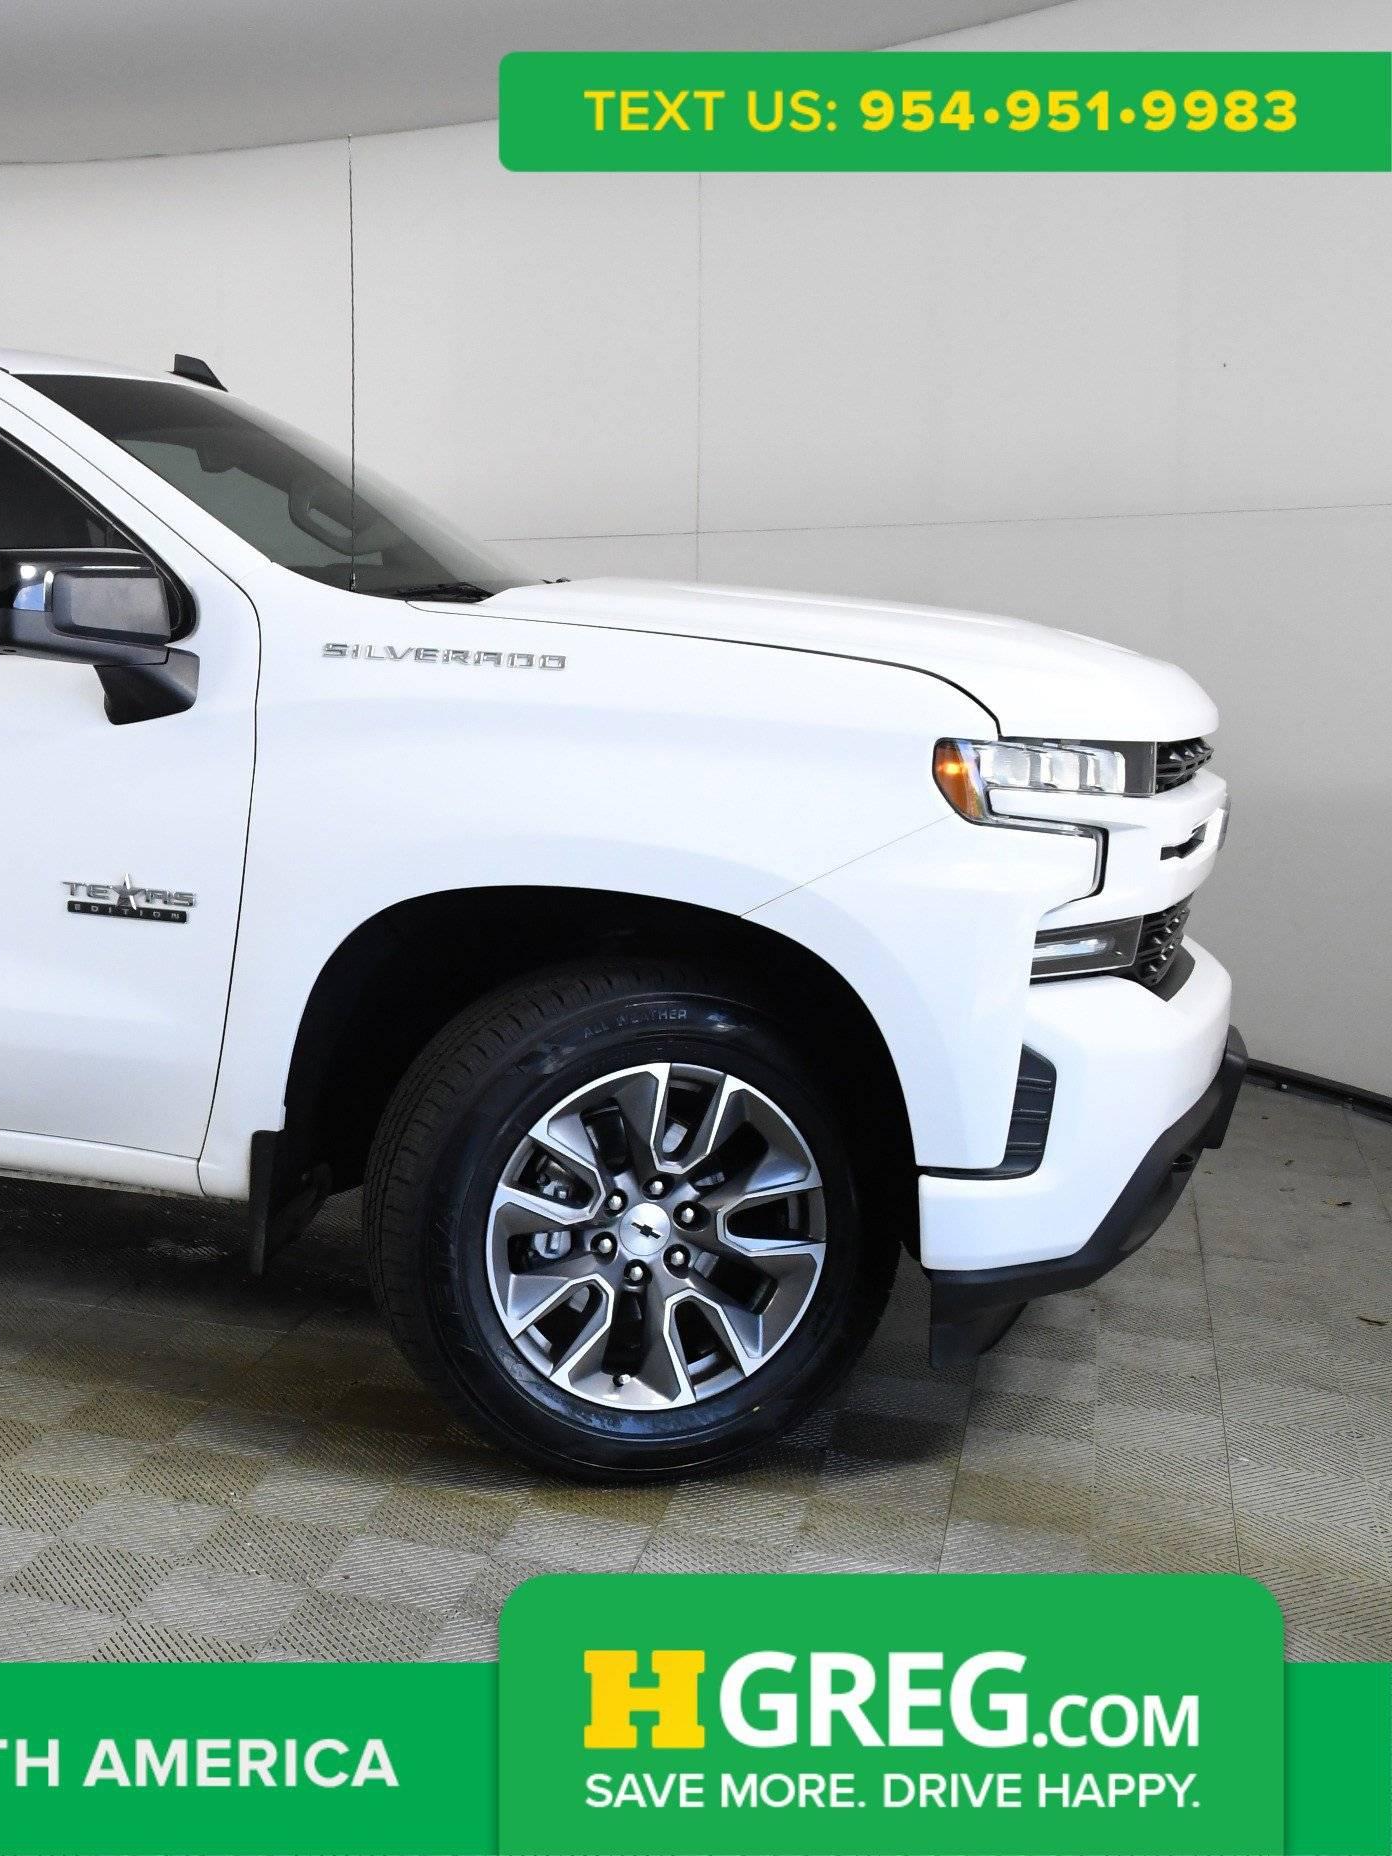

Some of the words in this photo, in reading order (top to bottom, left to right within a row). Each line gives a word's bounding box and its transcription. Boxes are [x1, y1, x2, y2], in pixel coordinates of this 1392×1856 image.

[321, 642, 567, 671] SILVERADO
[62, 872, 196, 907] TEXAS
[71, 902, 182, 921] EDITION
